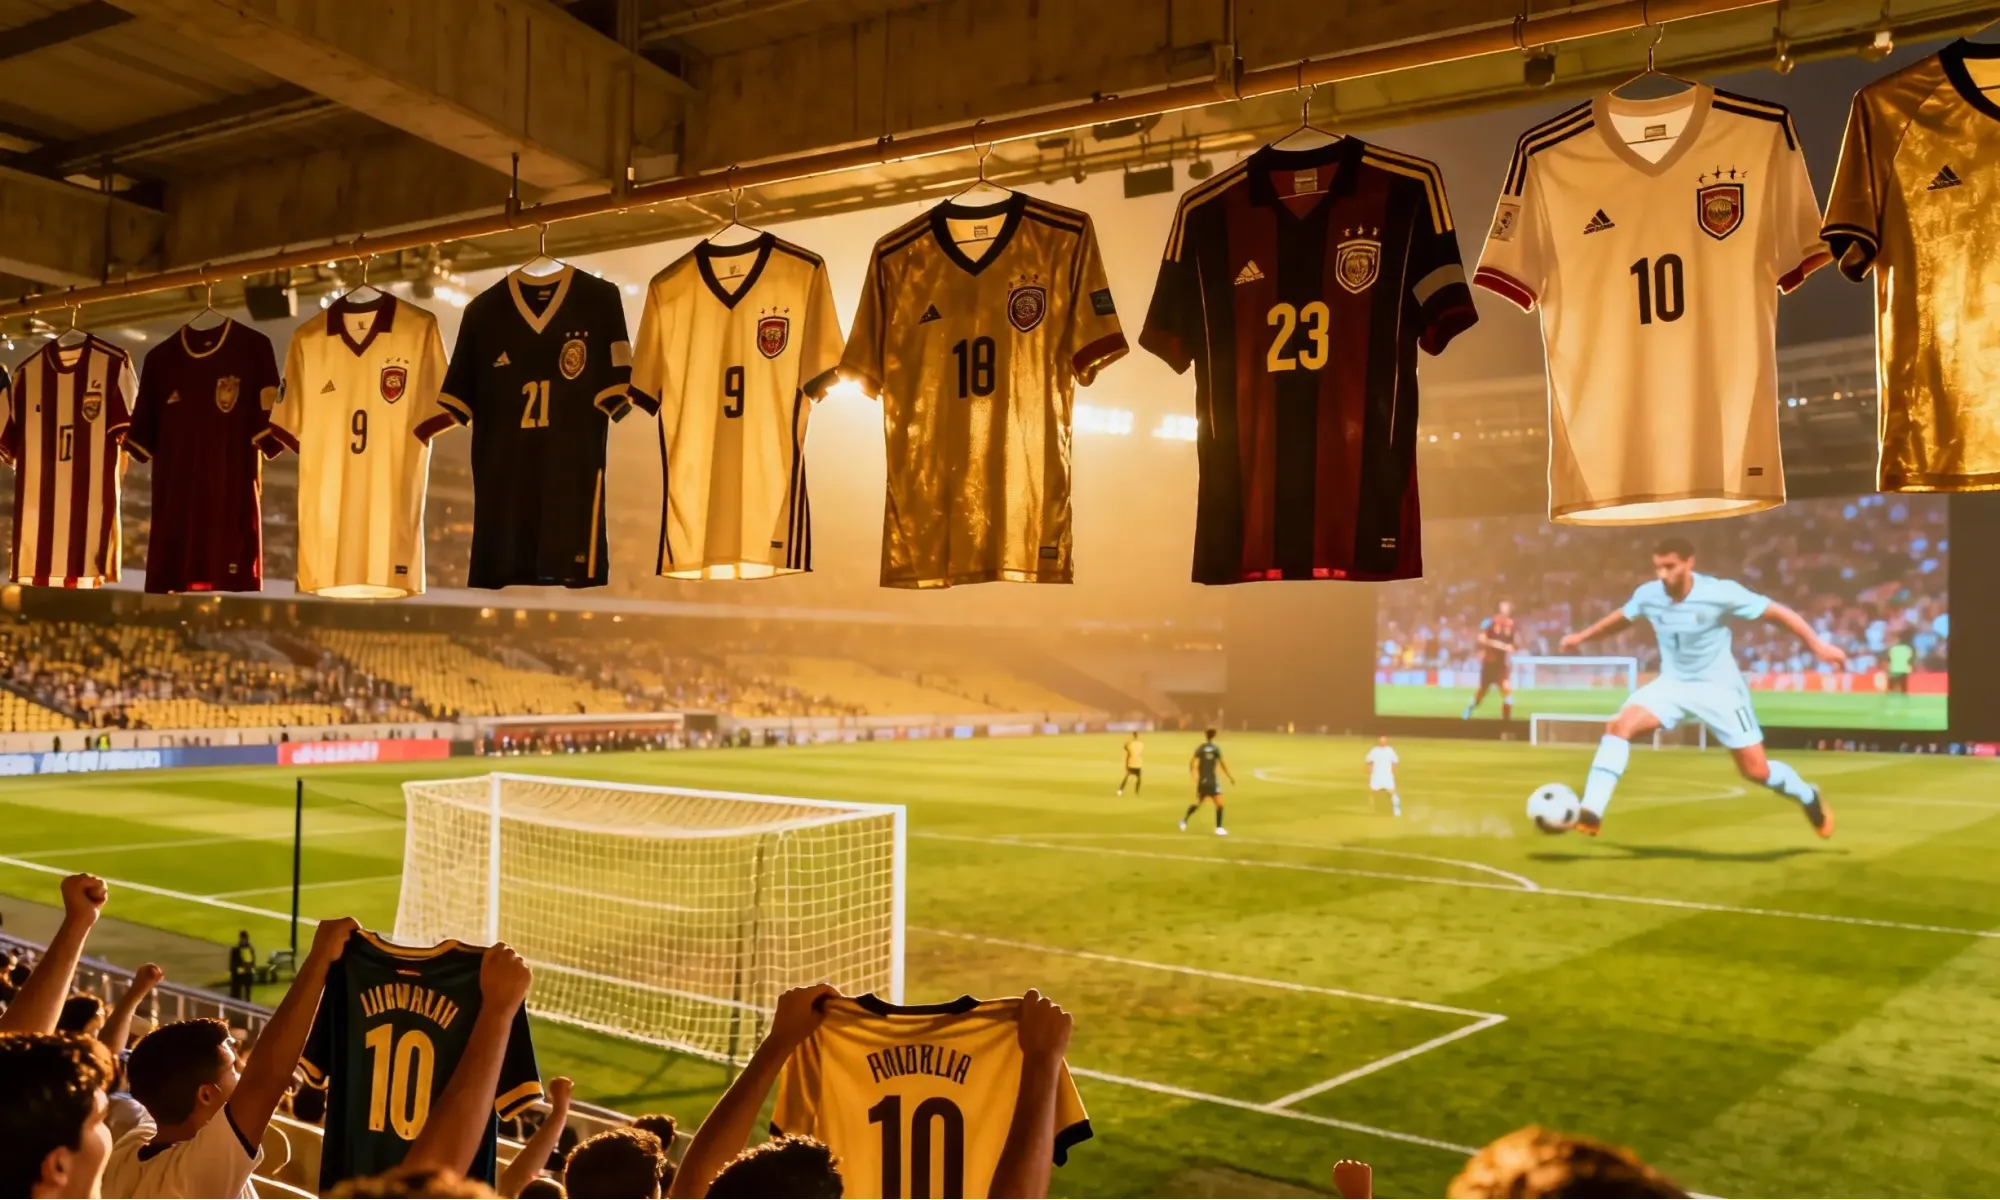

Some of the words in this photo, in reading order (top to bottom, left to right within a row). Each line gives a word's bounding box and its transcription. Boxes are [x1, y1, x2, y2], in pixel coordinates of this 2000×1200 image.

[1630, 253, 1685, 325] 10
[952, 335, 996, 399] 18
[1266, 301, 1331, 372] 23
[520, 380, 550, 429] 21
[723, 365, 745, 419] 9
[350, 409, 368, 455] 9
[365, 1023, 435, 1141] 10
[868, 1094, 964, 1200] 10
